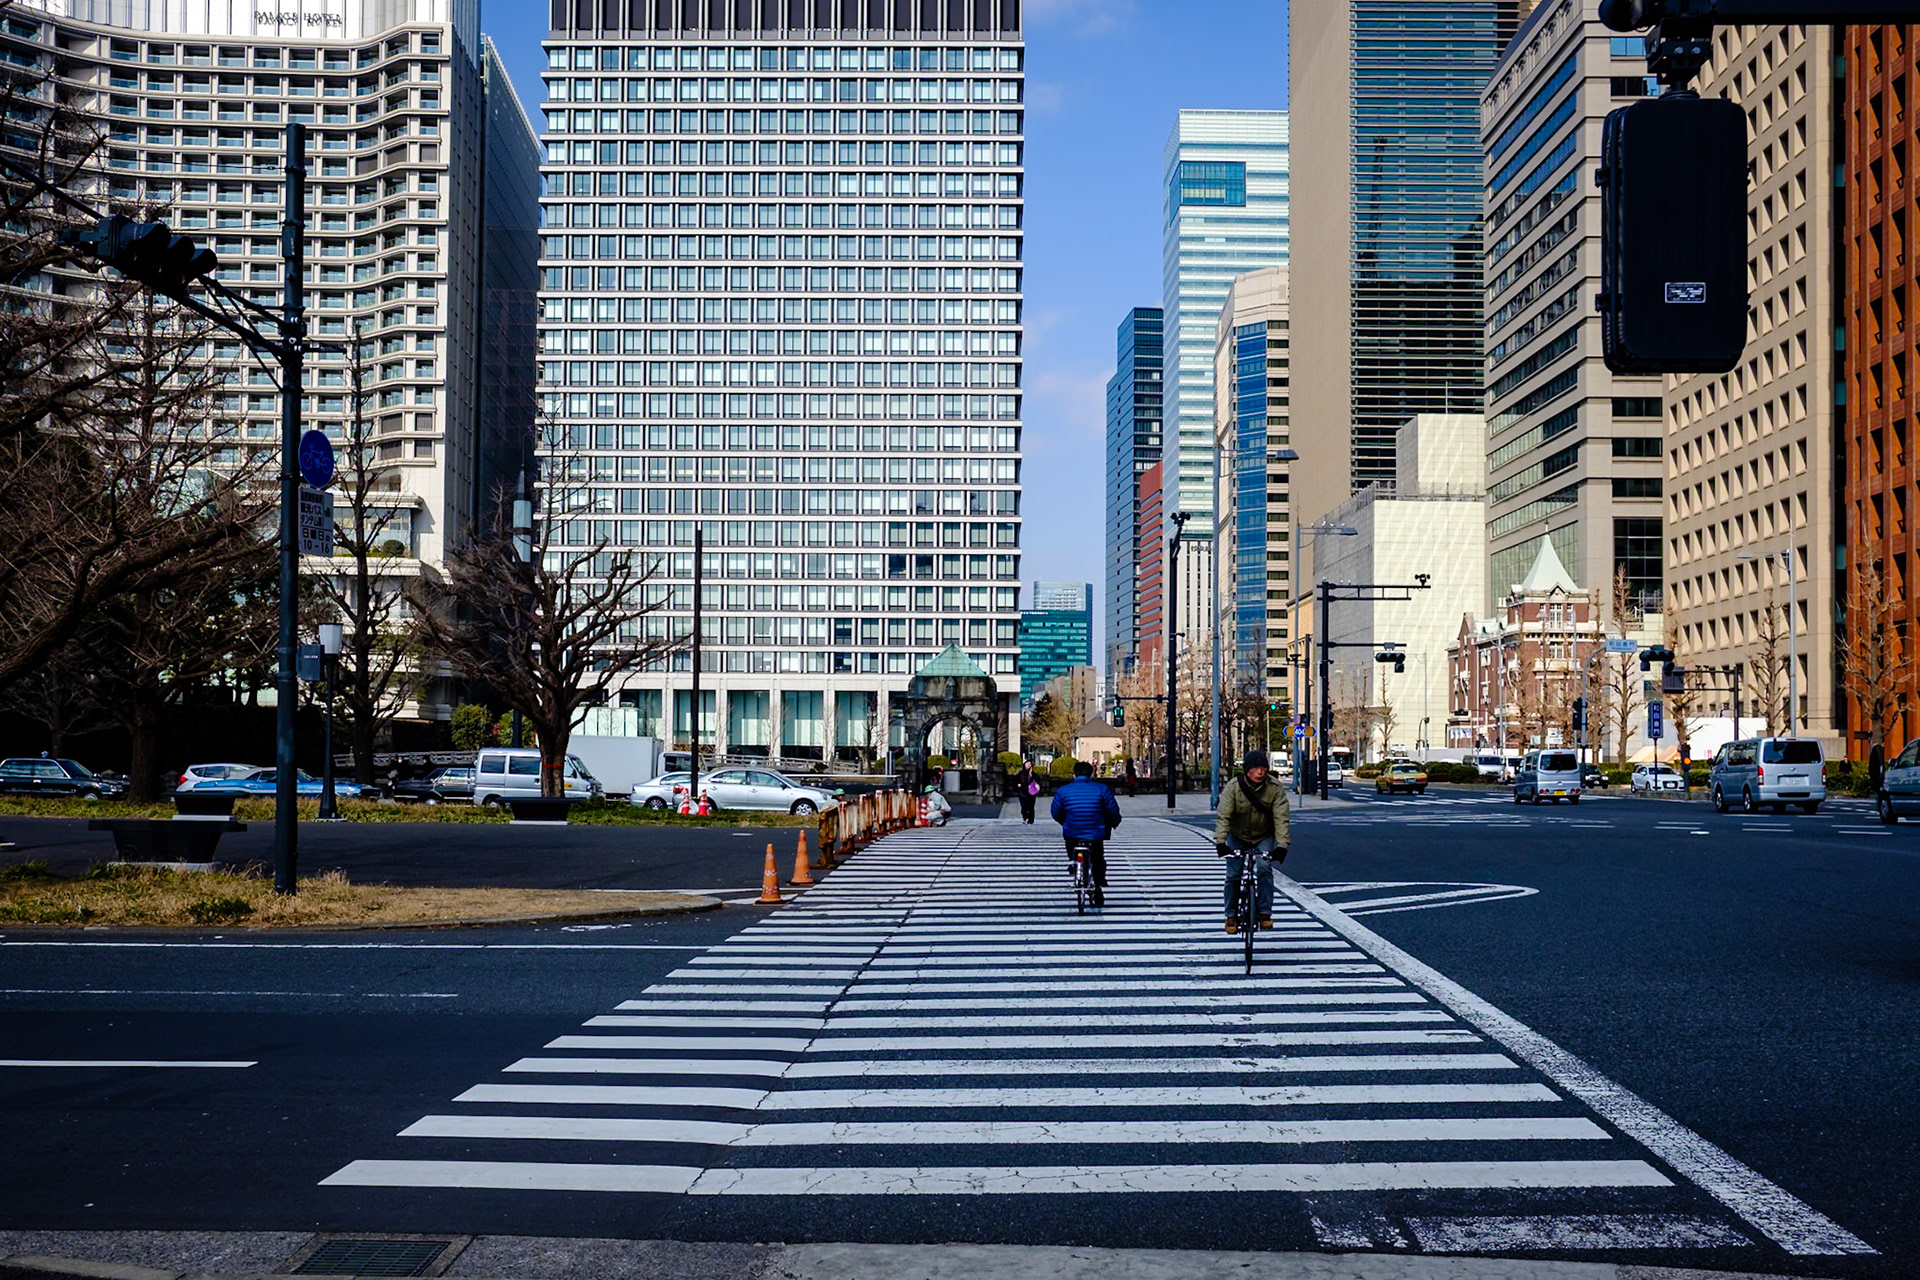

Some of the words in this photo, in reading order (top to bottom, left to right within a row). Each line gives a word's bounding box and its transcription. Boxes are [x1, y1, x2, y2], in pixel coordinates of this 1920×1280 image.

[254, 11, 298, 24] PALACE
[303, 13, 342, 25] HOTEL
[301, 502, 322, 516] 光バス
[302, 527, 330, 541] 日日の
[303, 538, 329, 554] 10-16
